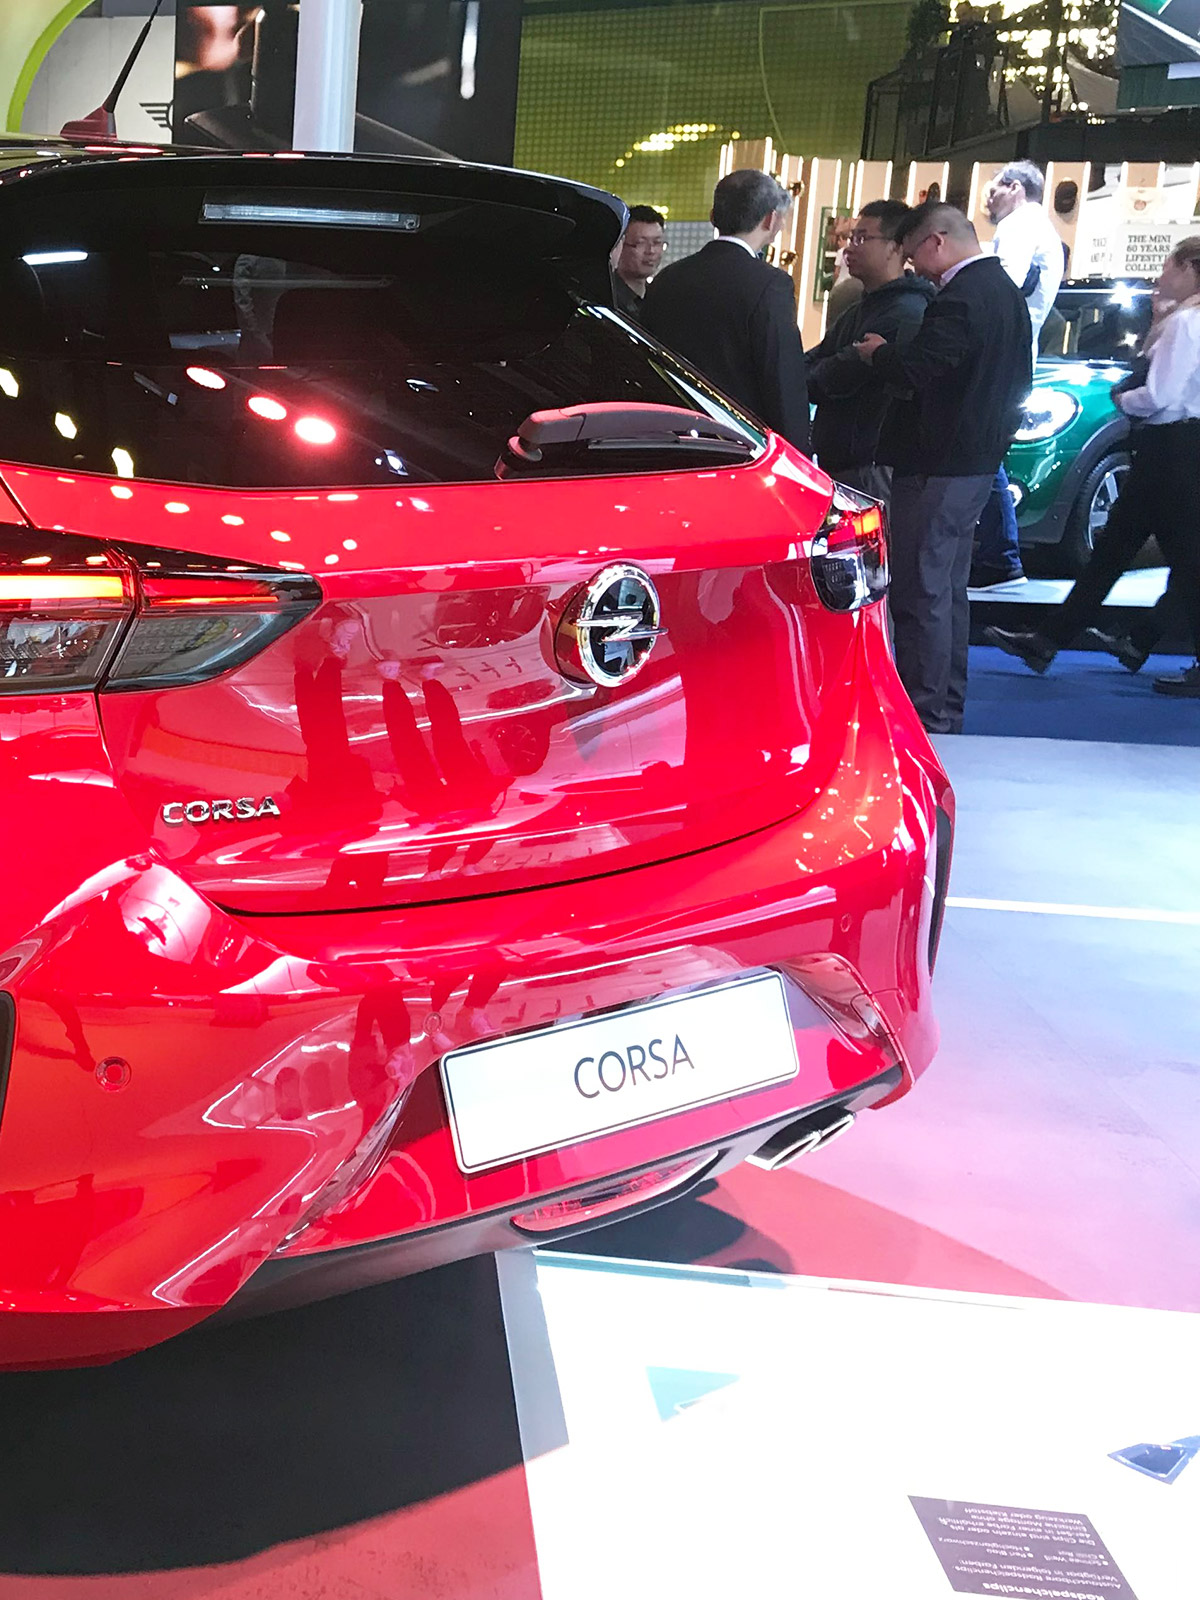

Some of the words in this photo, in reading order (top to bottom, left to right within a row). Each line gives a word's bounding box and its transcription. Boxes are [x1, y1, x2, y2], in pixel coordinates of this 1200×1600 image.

[1128, 235, 1147, 243] THE
[1149, 235, 1171, 243] MINI
[1140, 245, 1171, 253] YEARS
[163, 797, 280, 823] CORSA
[574, 1034, 695, 1099] CORSA
